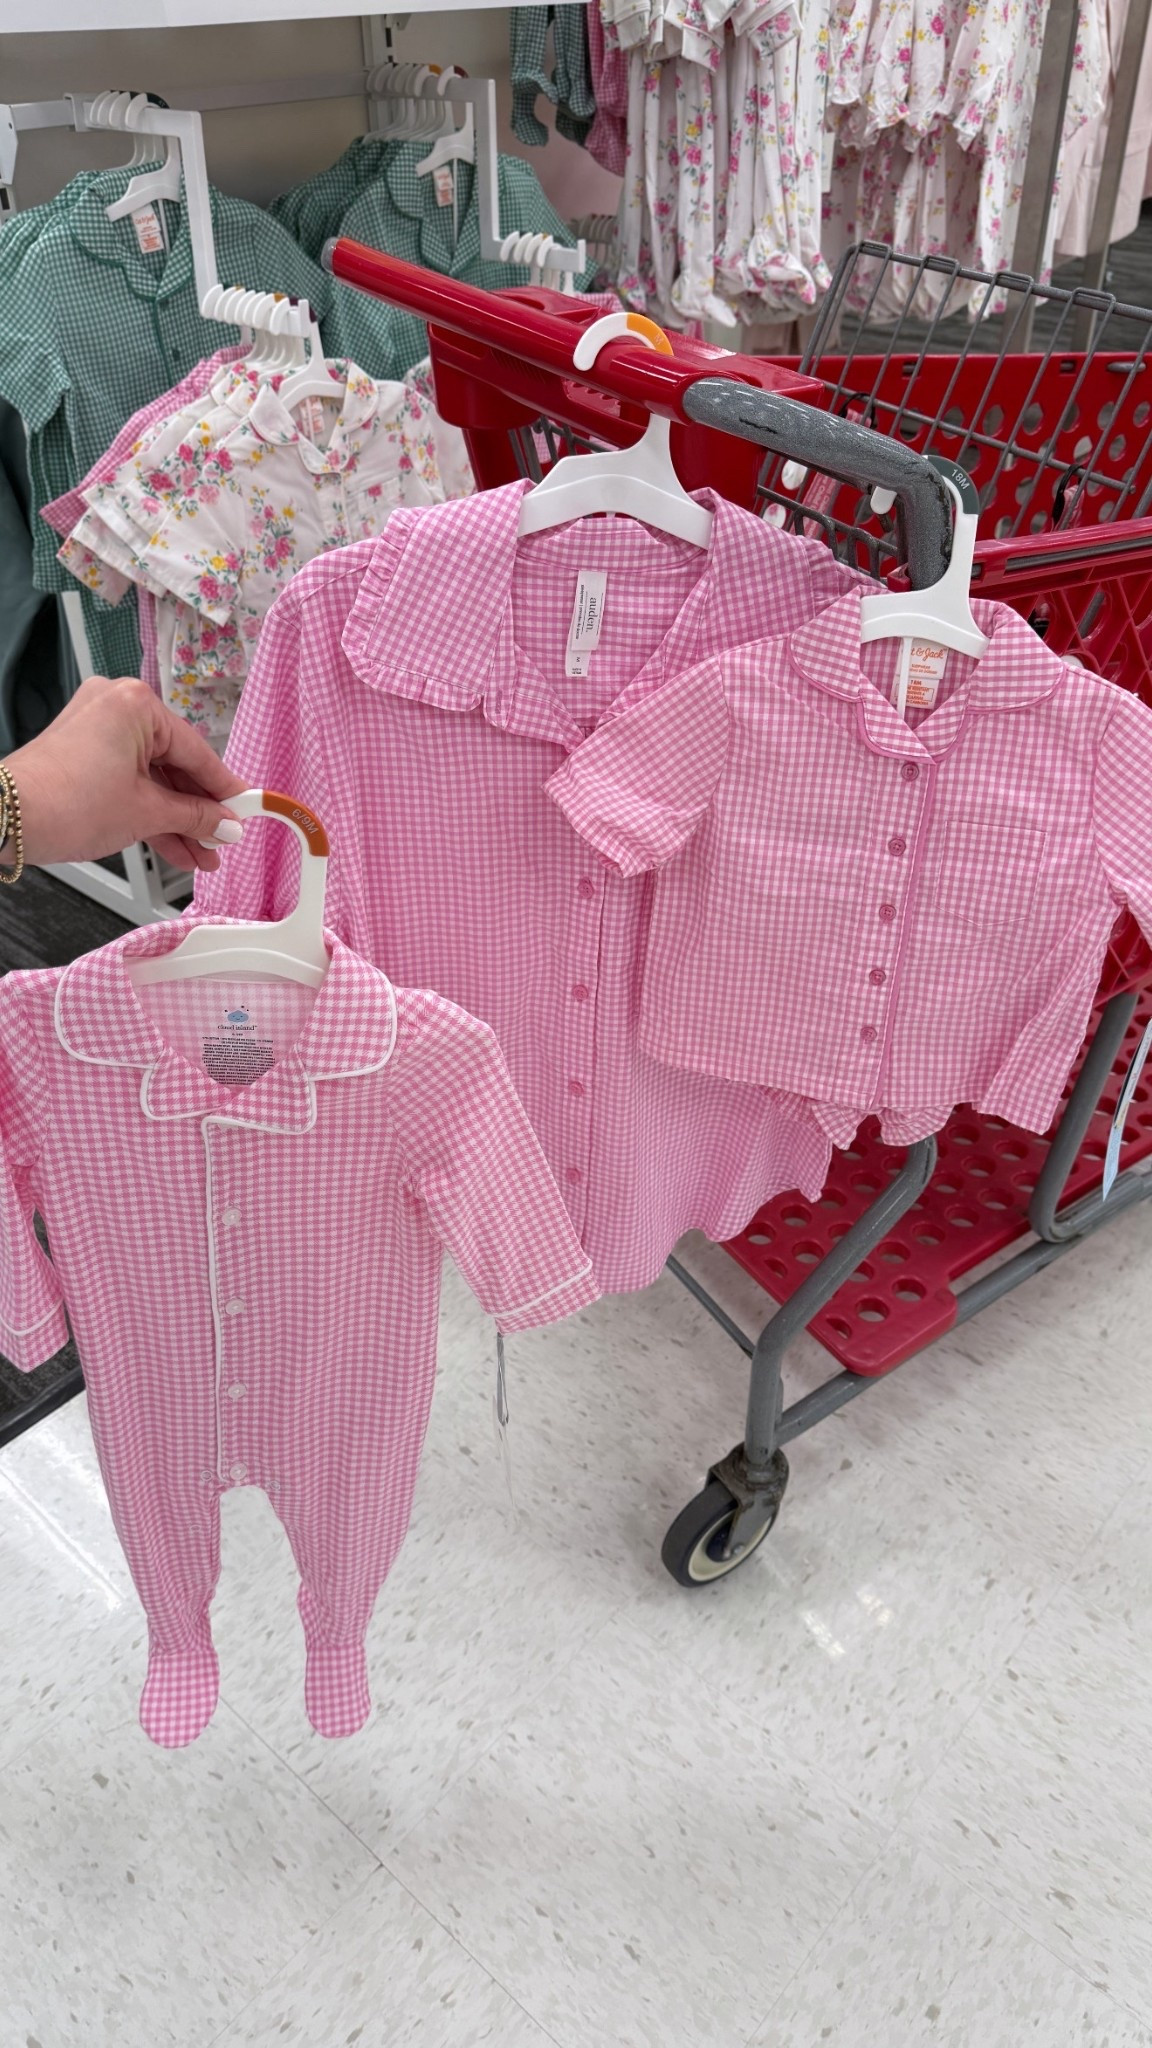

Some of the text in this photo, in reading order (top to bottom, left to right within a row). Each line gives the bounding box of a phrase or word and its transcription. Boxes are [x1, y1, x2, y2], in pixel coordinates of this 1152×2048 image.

[951, 468, 971, 490] 18M
[586, 597, 598, 633] auden.
[916, 647, 924, 656] &
[292, 808, 319, 834] 6/9M
